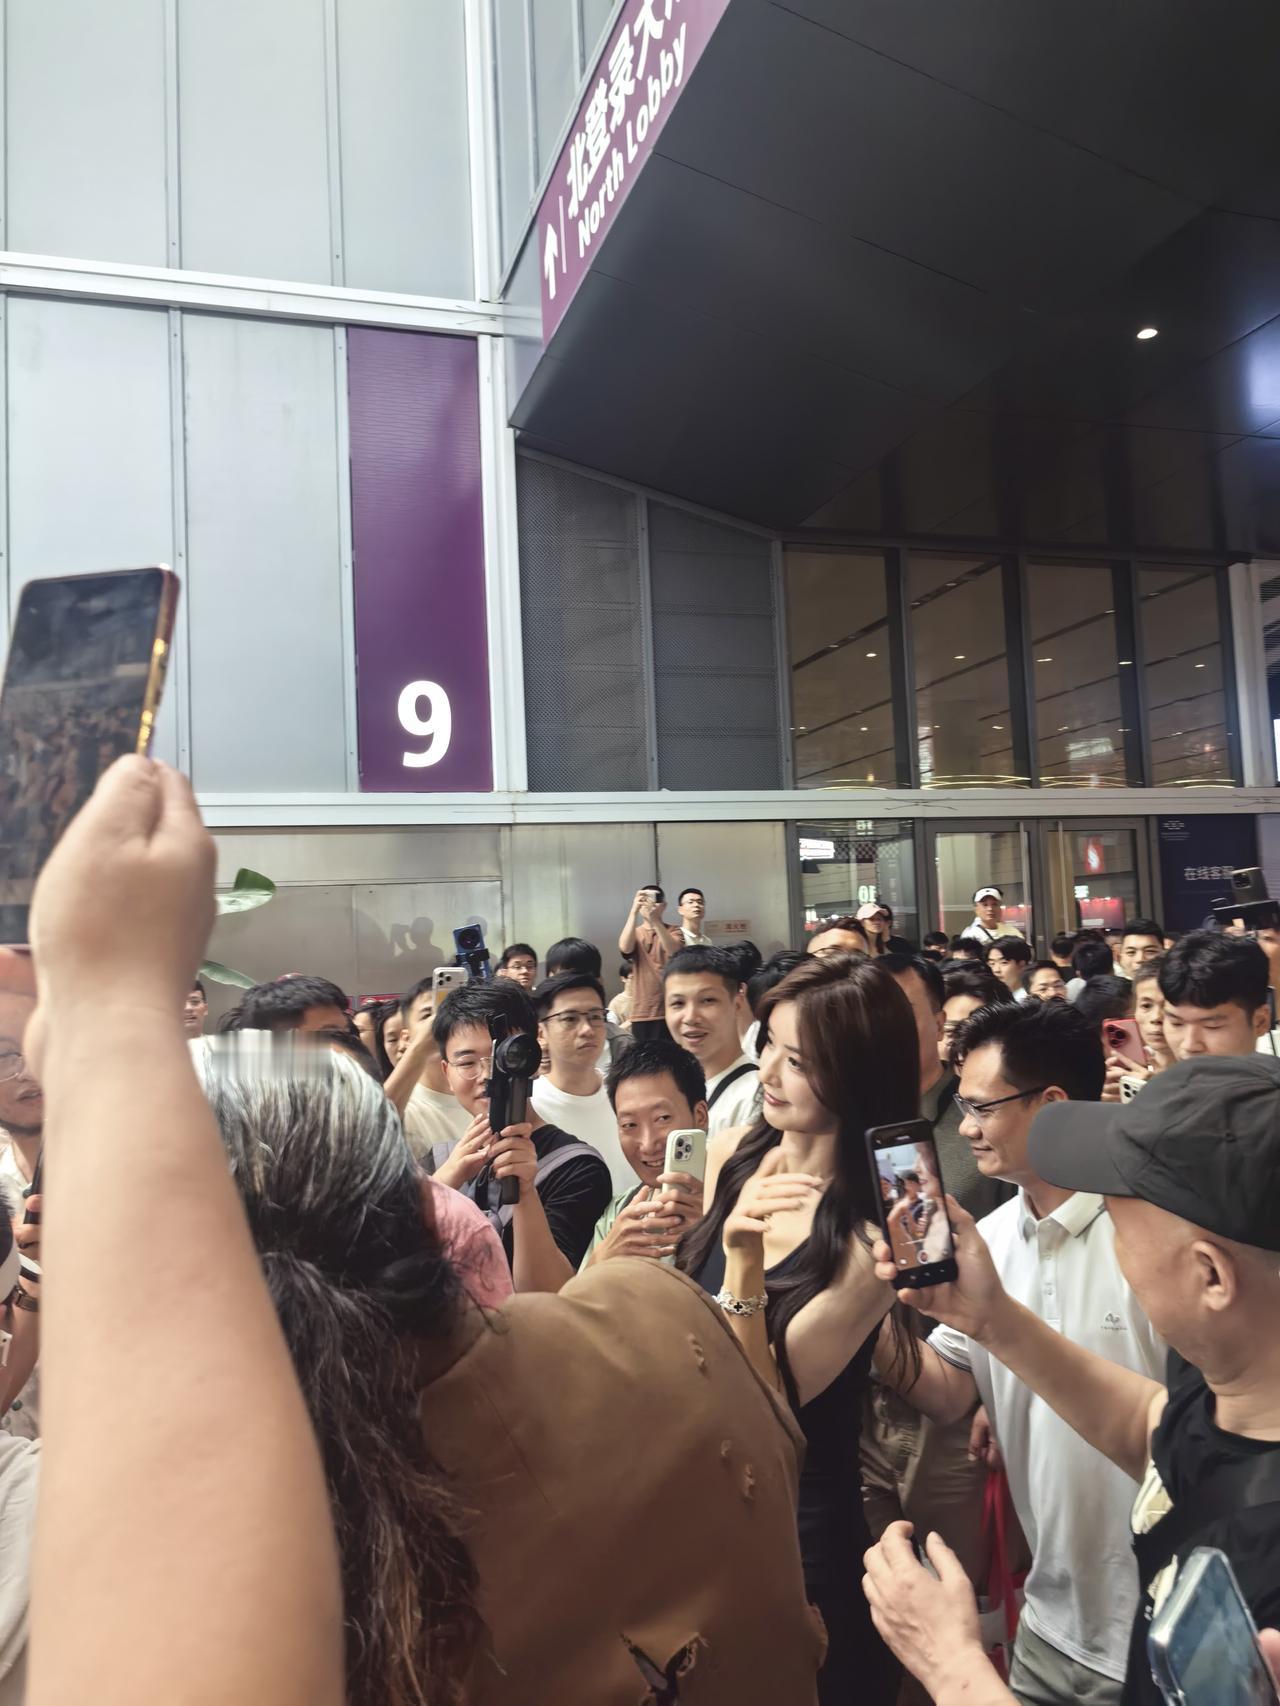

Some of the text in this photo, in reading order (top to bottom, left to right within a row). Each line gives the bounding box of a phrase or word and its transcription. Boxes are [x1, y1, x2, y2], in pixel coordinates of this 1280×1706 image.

[567, 0, 681, 219] 北登录大
[578, 22, 687, 258] North Lobby
[398, 680, 452, 768] 9
